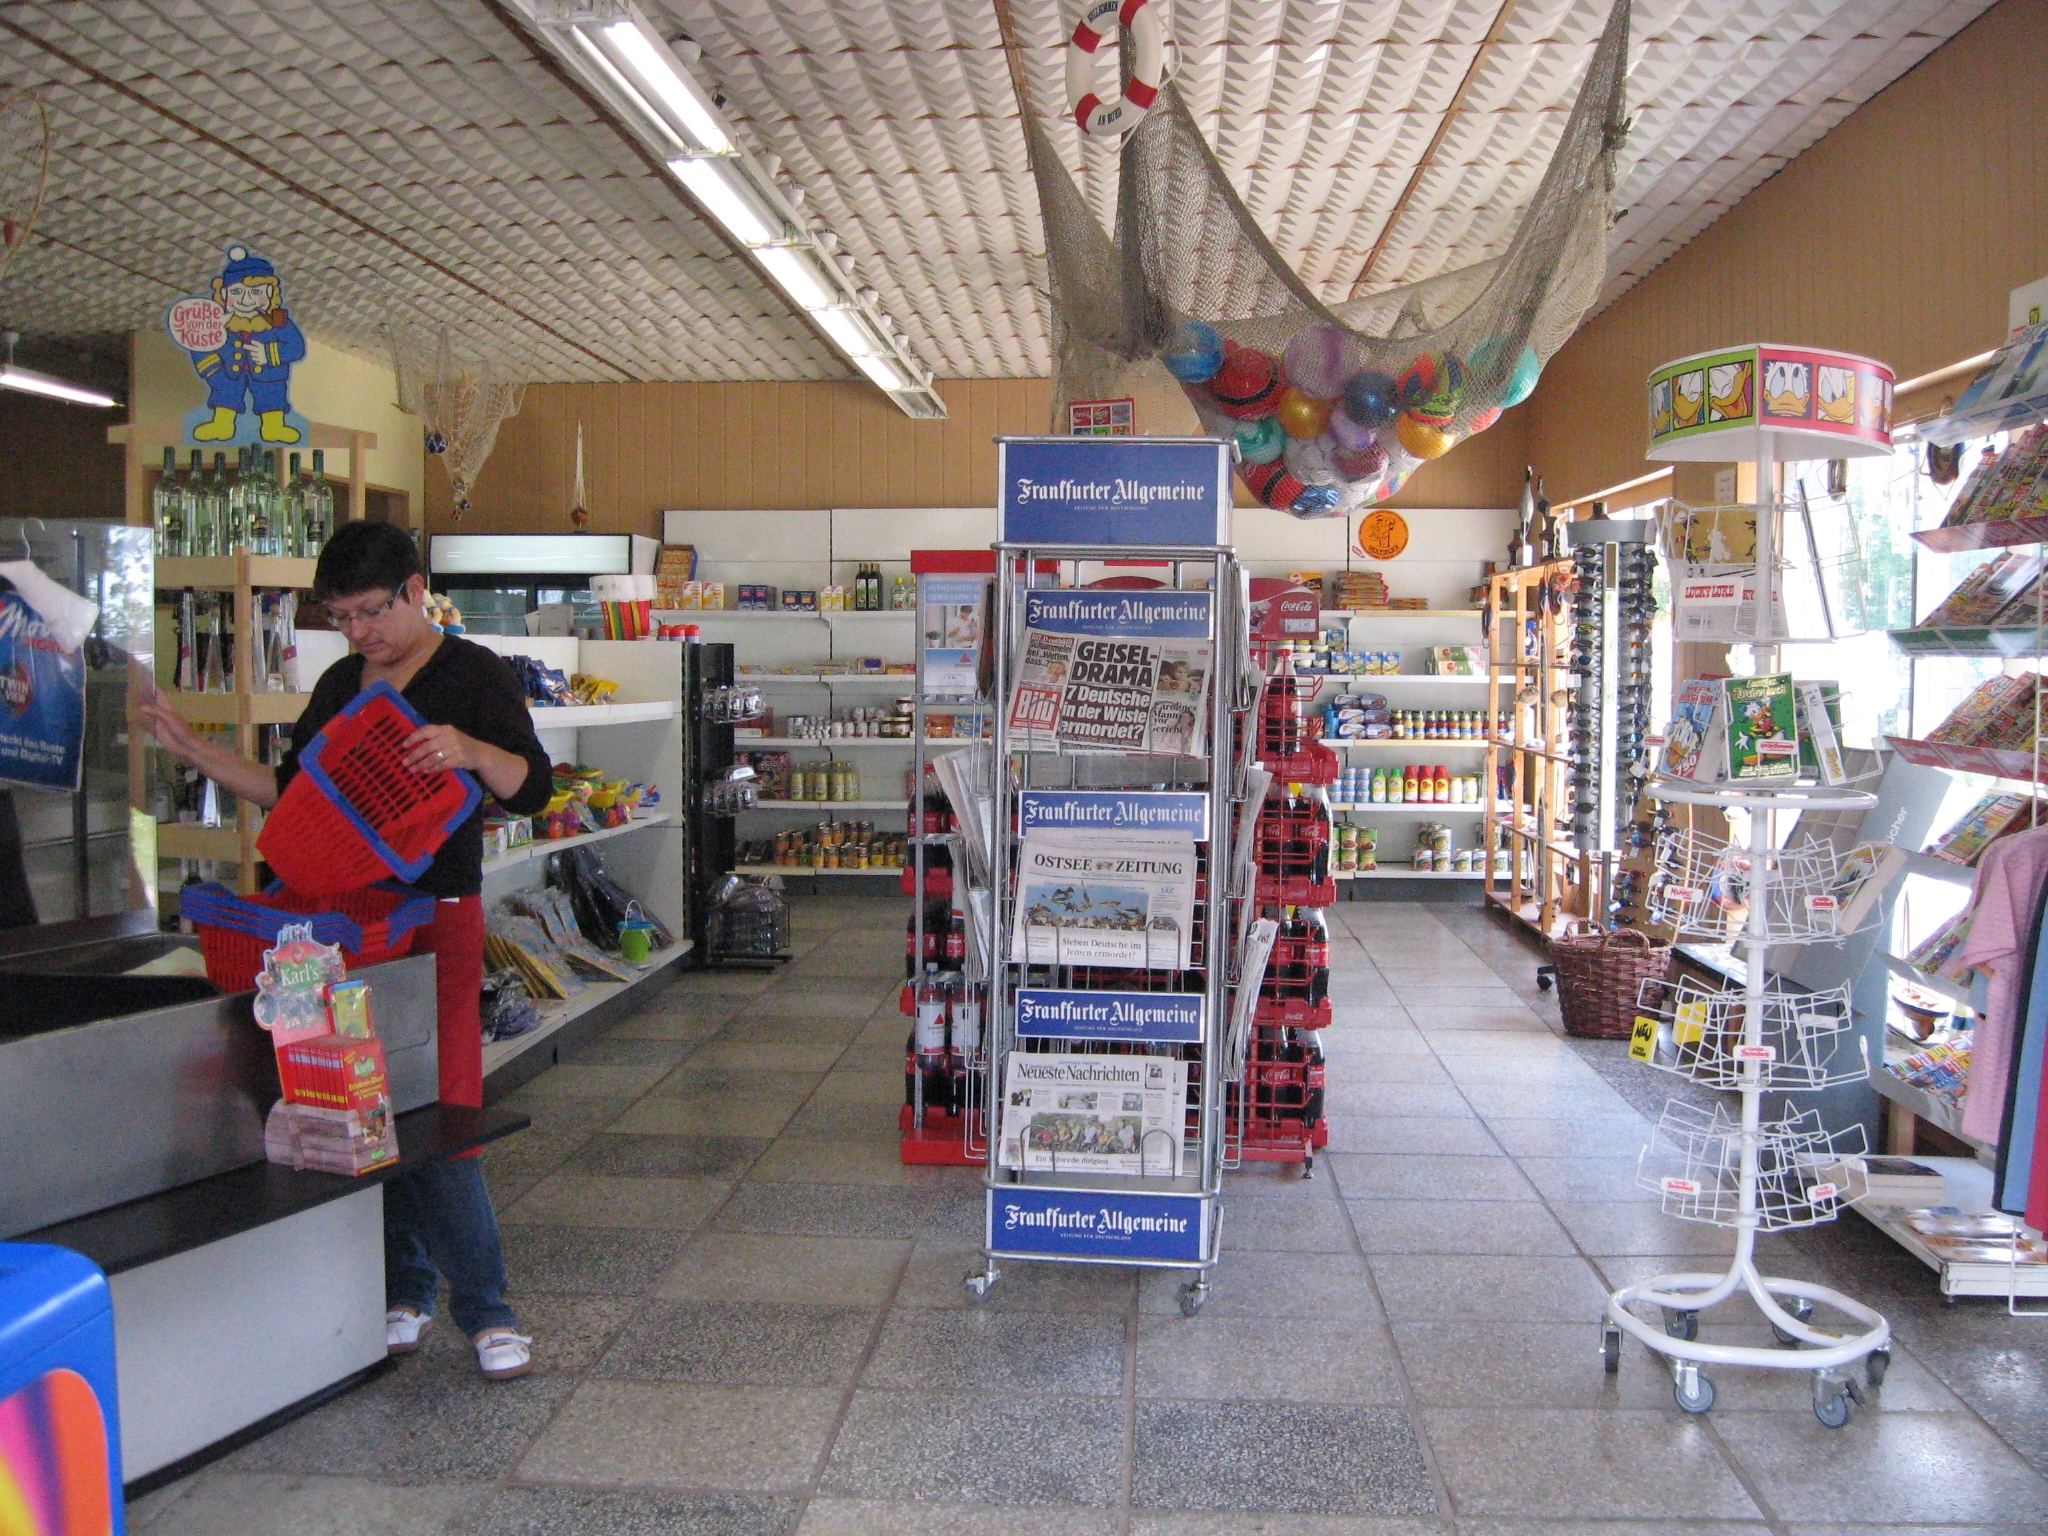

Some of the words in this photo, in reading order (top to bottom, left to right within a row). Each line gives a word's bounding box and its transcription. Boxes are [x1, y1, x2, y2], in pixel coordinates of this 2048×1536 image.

[174, 301, 221, 329] Grüße
[187, 321, 204, 329] von
[206, 320, 222, 329] der
[175, 329, 222, 347] Küste
[1017, 478, 1111, 505] Frankfurter
[1112, 478, 1205, 504] Allgemeine
[1685, 586, 1711, 599] LUCKY
[1712, 585, 1735, 598] LUKE
[1029, 599, 1117, 624] Frankfurter
[1118, 599, 1206, 624] Allgemeine
[1077, 640, 1158, 666] GEISEL-
[1071, 661, 1153, 688] DRAMA
[1016, 689, 1058, 721] Bild
[1067, 685, 1076, 699] 7
[1078, 685, 1150, 708] Deutsche
[1062, 702, 1075, 717] in
[1077, 703, 1102, 720] der
[1103, 705, 1149, 724] Wüste
[1058, 721, 1144, 740] ermordet?
[1024, 799, 1113, 825] Frankfurter
[1113, 801, 1202, 826] Allgemeine
[1034, 853, 1093, 871] OSTSEE
[1114, 859, 1183, 875] ZEITUNG
[1062, 937, 1089, 947] Sieben
[1091, 939, 1129, 949] Deutsche
[1130, 941, 1142, 950] im
[1094, 950, 1136, 960] ermordet?
[280, 963, 320, 987] Karl's
[1021, 998, 1109, 1024] Frankfurter
[1110, 1001, 1198, 1026] Allgemeine
[1635, 1023, 1652, 1042] NEU
[1017, 1063, 1066, 1081] Neueste
[1066, 1064, 1140, 1082] Nachrichten
[1035, 1155, 1047, 1164] Ein
[1048, 1156, 1080, 1165] Shwede
[1005, 1204, 1096, 1232] Frankfurter
[1096, 1208, 1188, 1235] Allgemeine
